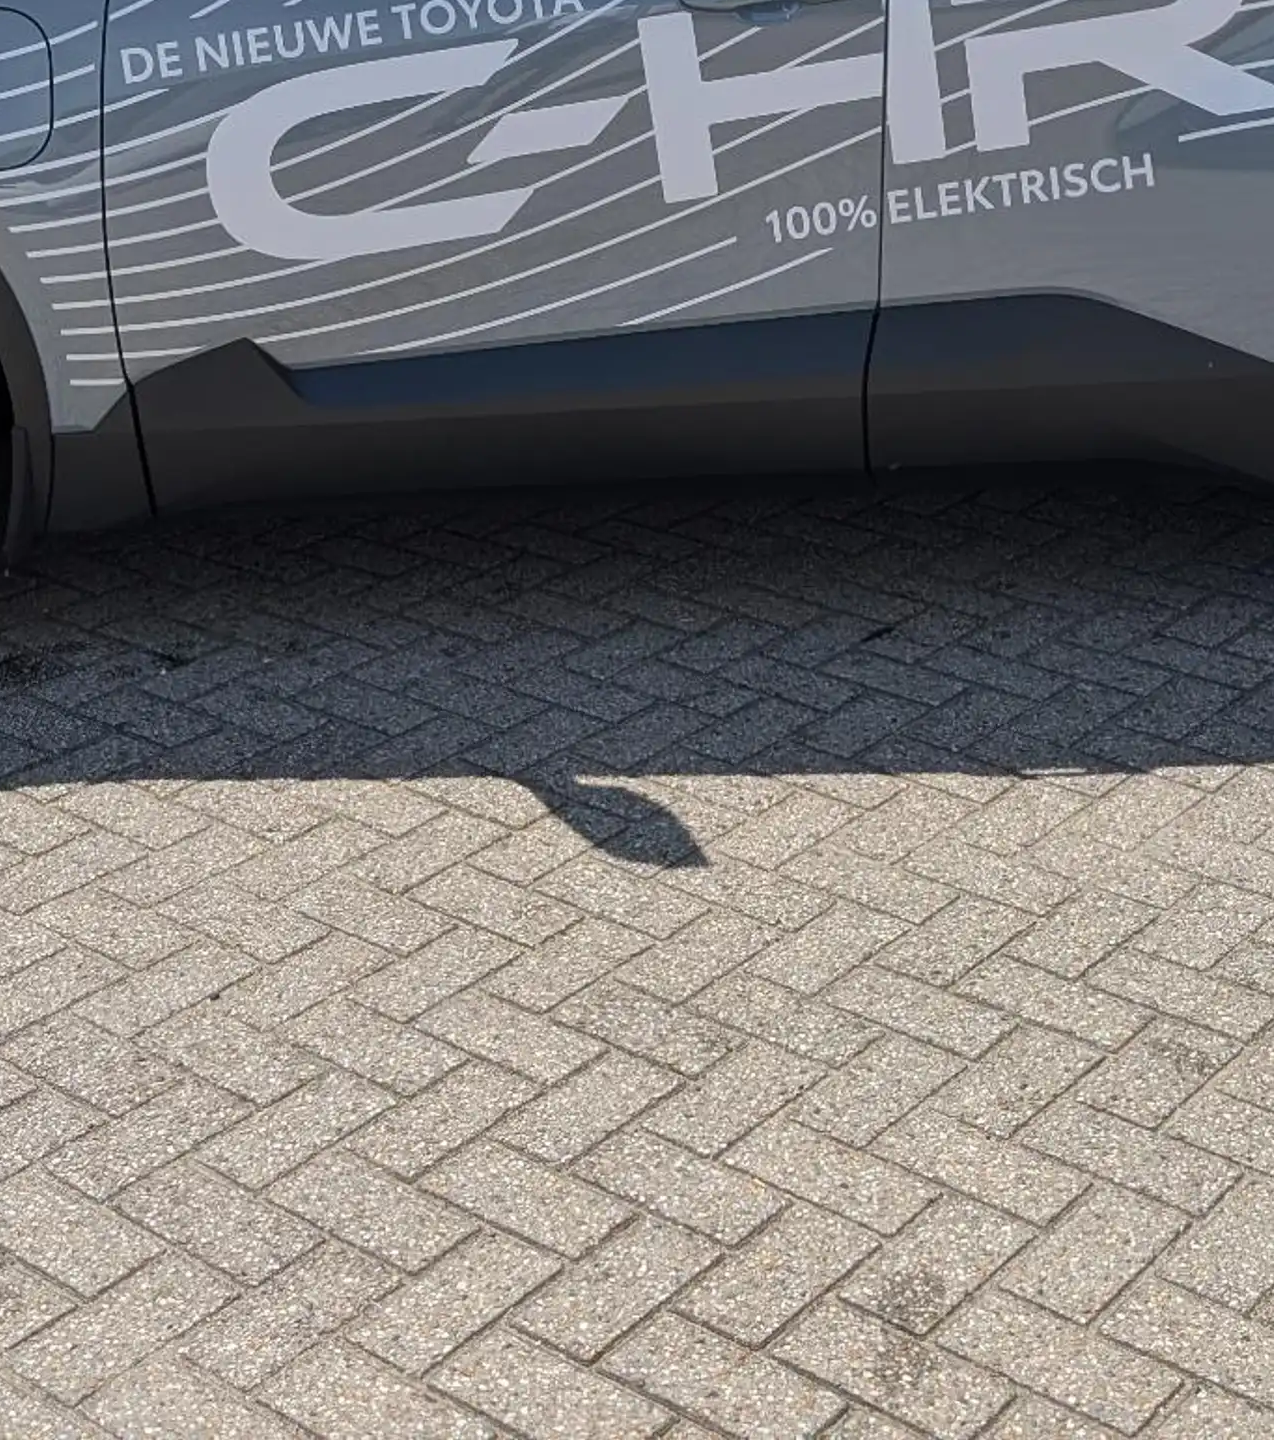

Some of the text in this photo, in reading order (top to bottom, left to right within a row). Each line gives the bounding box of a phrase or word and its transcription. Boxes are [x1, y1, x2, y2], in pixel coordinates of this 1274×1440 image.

[121, 42, 183, 85] DE
[194, 9, 383, 72] NIEUWE
[765, 153, 1156, 243] 100% ELEKTRISCH
